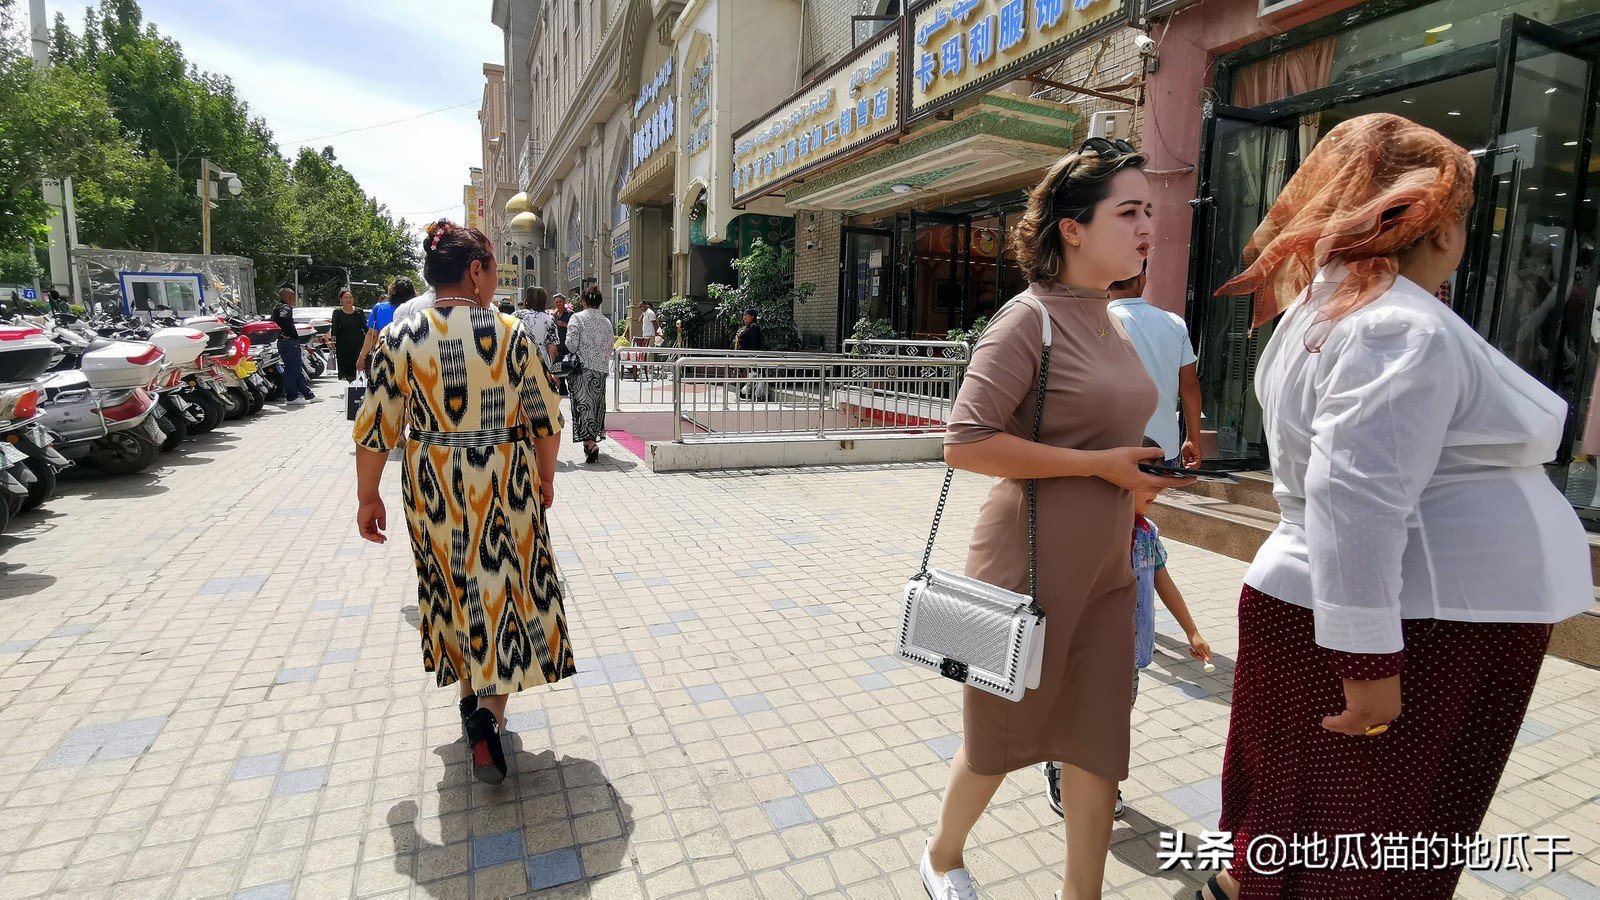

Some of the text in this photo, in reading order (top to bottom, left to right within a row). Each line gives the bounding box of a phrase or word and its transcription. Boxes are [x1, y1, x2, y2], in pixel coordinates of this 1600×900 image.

[913, 0, 1093, 94] 卡玛利服饰
